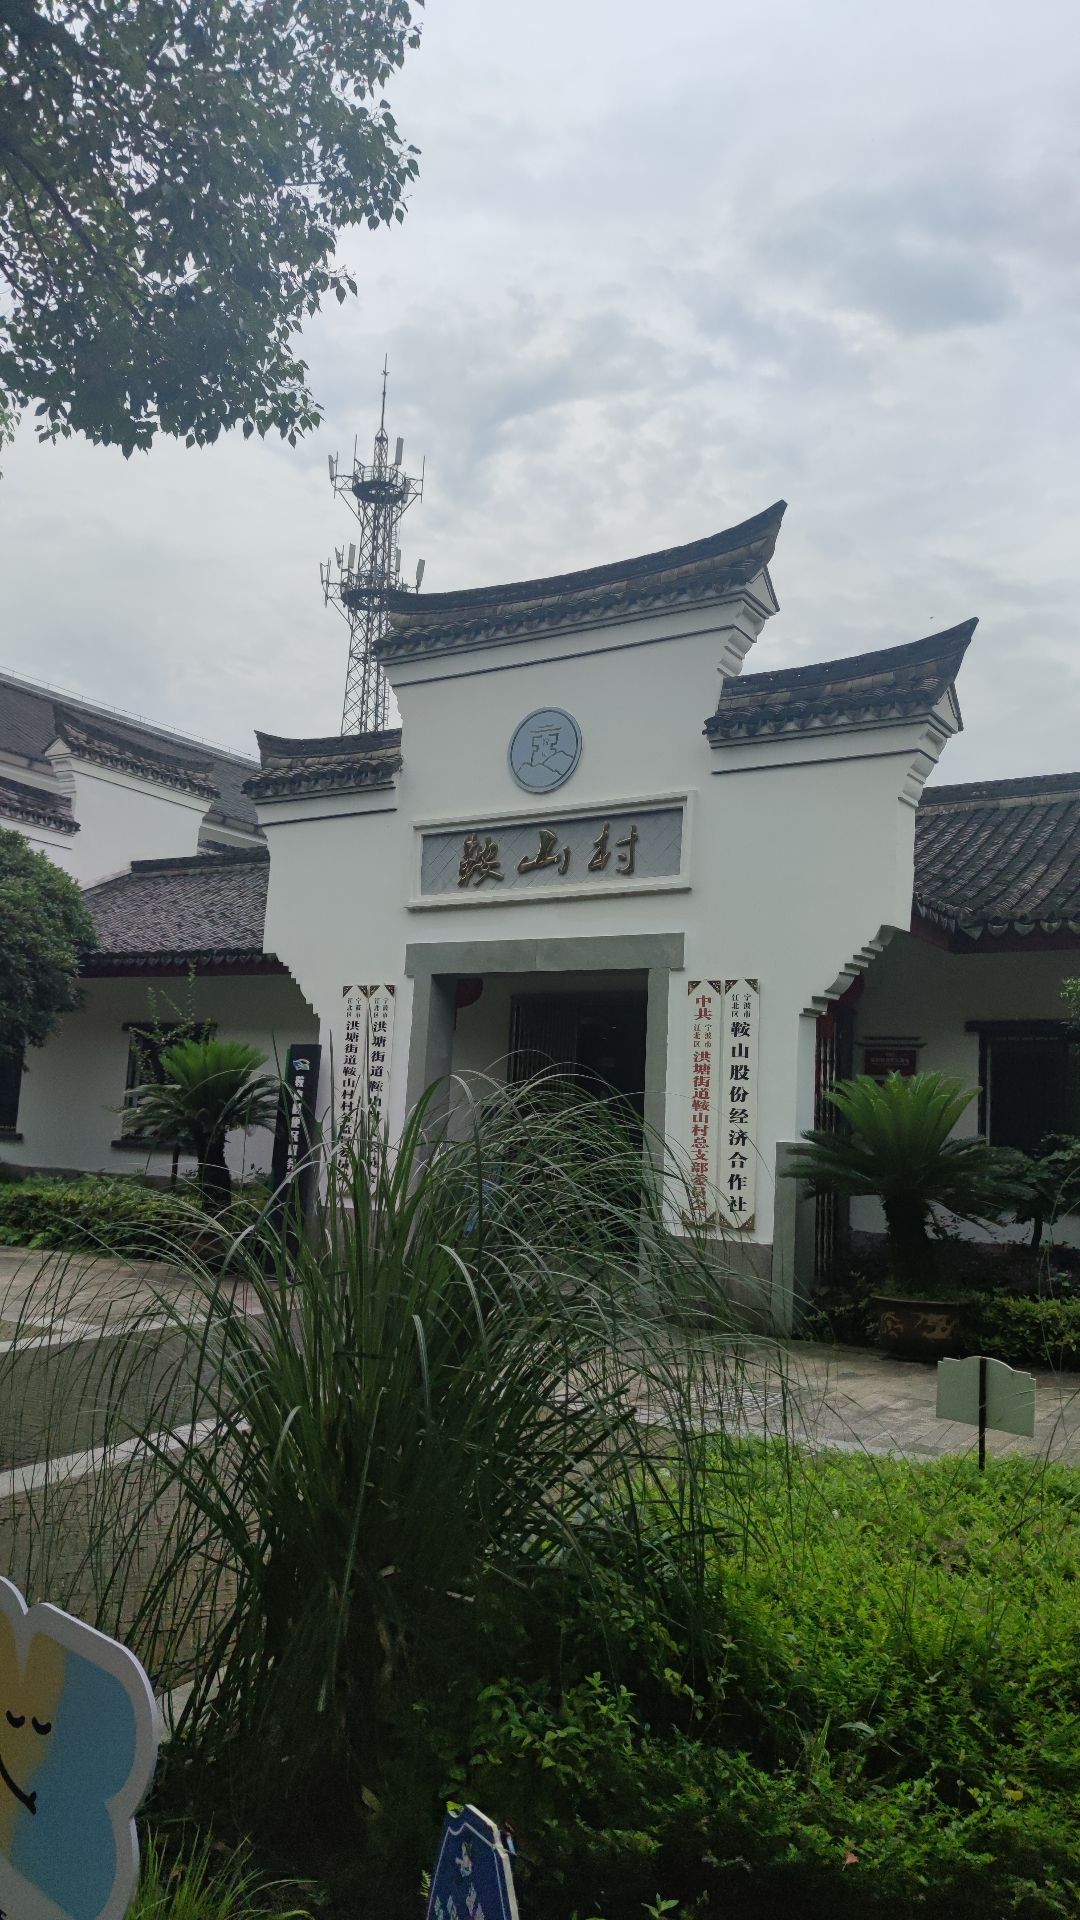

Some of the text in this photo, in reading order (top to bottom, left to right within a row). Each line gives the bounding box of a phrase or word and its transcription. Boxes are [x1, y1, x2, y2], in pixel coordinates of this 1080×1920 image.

[457, 821, 639, 888] 鞍山村
[695, 994, 712, 1020] 中共
[731, 993, 740, 1018] 江北区
[743, 993, 752, 1018] 宁波市
[728, 1021, 751, 1213] 鞍山股份经济合作社
